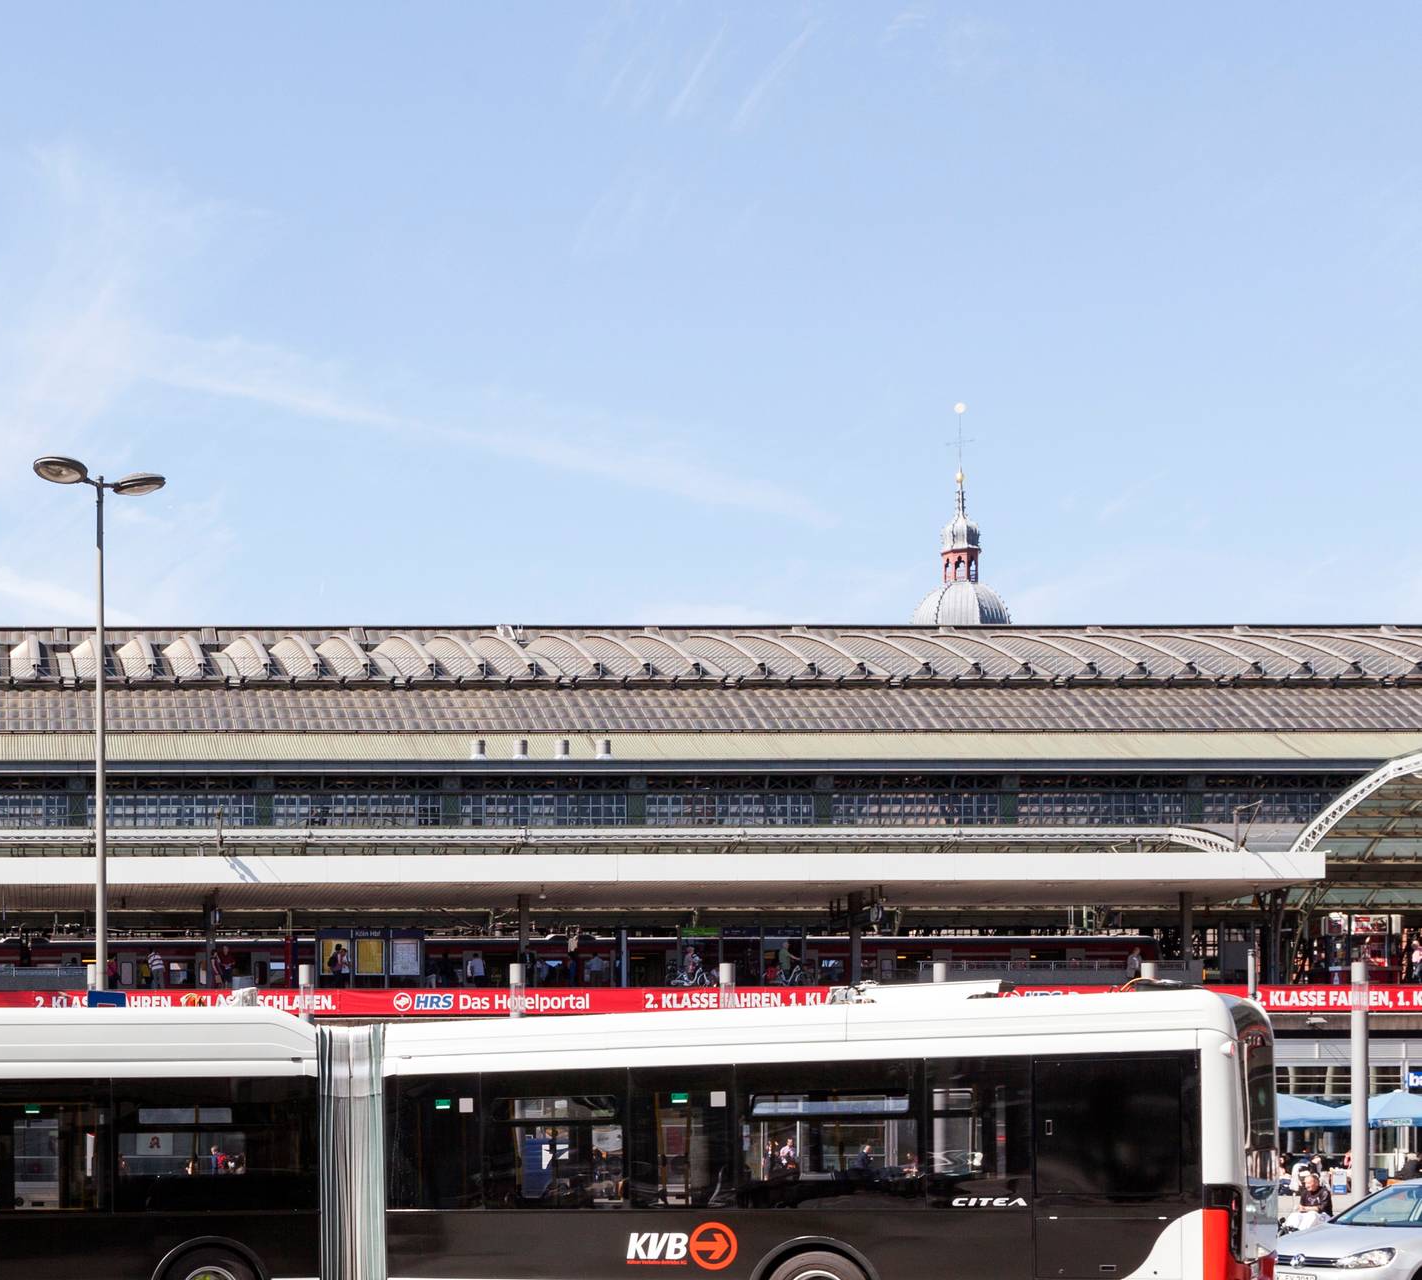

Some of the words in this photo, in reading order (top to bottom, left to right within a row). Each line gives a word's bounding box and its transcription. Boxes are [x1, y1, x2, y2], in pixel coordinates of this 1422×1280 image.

[414, 993, 454, 1011] HRS
[459, 994, 489, 1010] Das
[495, 993, 590, 1013] Hotelportal
[645, 993, 659, 1009] 2.
[662, 993, 718, 1009] KLASSE
[789, 992, 802, 1008] 1.
[1269, 990, 1326, 1007] KLASSE
[1397, 990, 1410, 1007] 1.
[952, 1197, 1028, 1207] CITEA
[626, 1232, 689, 1260] KVB
